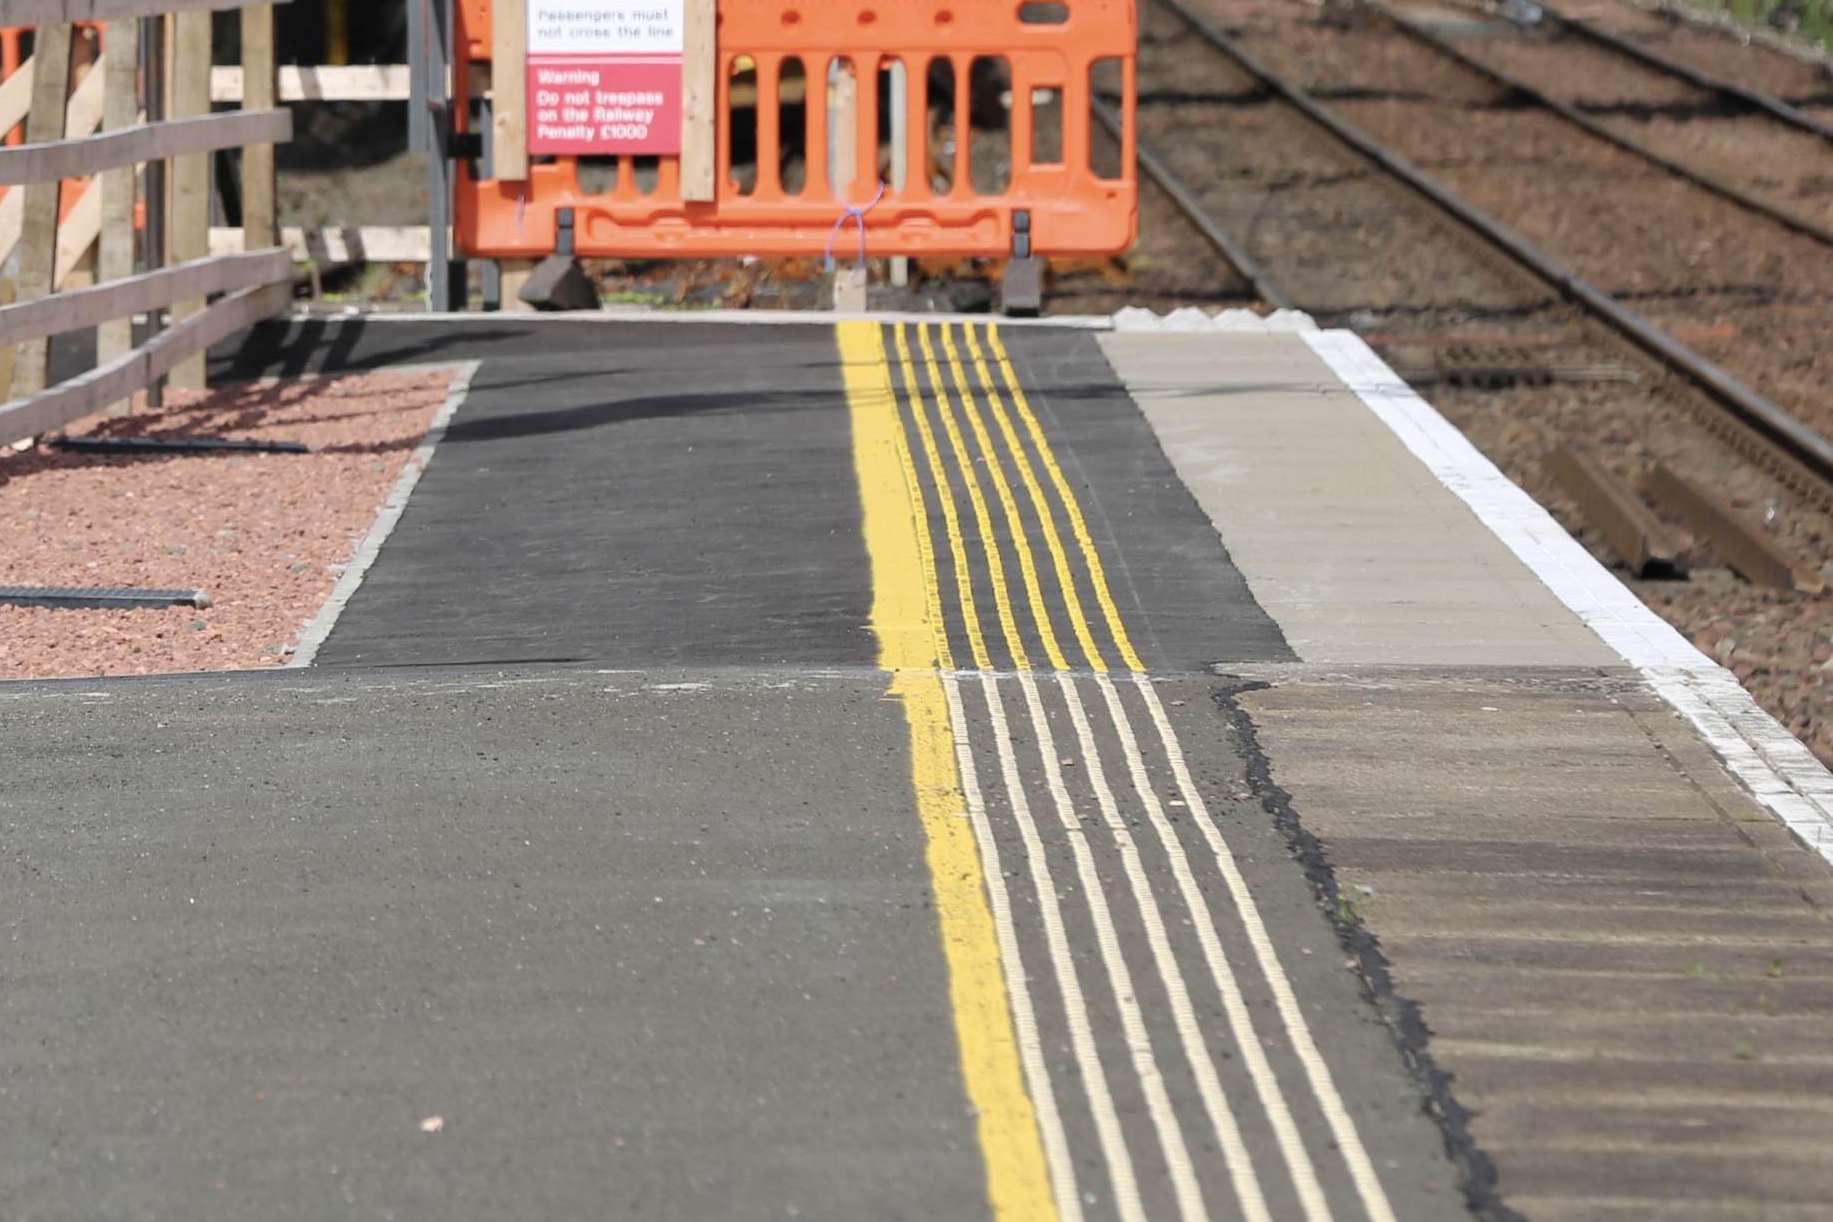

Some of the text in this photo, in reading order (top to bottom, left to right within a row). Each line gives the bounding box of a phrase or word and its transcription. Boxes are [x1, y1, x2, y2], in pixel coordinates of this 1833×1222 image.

[537, 9, 669, 23] Passengers must
[537, 24, 674, 38] not cross the line
[536, 68, 601, 87] Warning
[536, 89, 664, 107] Do not trespass
[536, 106, 655, 125] on the Railway
[536, 123, 649, 142] Penalty £1000
